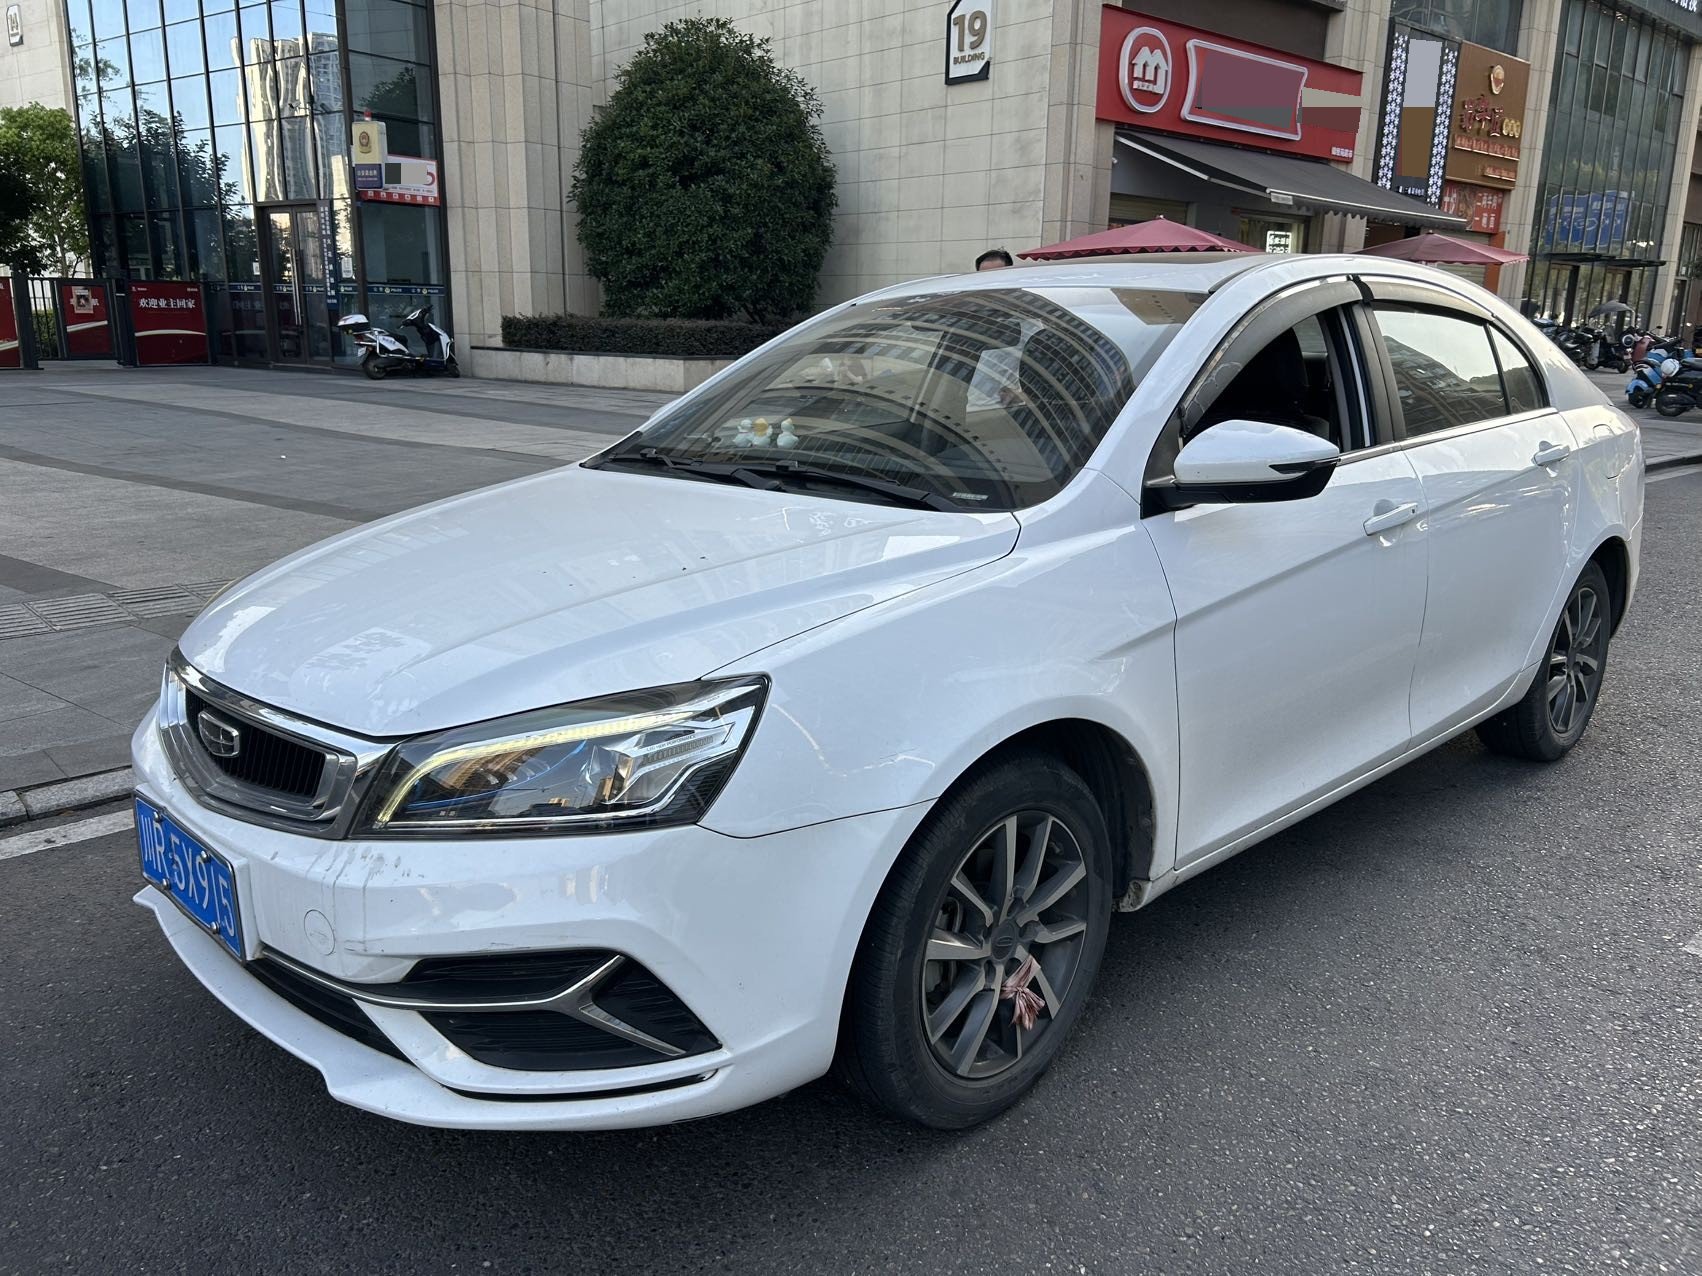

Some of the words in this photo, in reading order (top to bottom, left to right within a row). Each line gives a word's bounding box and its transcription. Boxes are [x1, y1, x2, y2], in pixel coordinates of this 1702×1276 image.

[953, 10, 987, 52] 19
[953, 52, 985, 65] BUILDING
[138, 298, 196, 309] 欢迎业主回家
